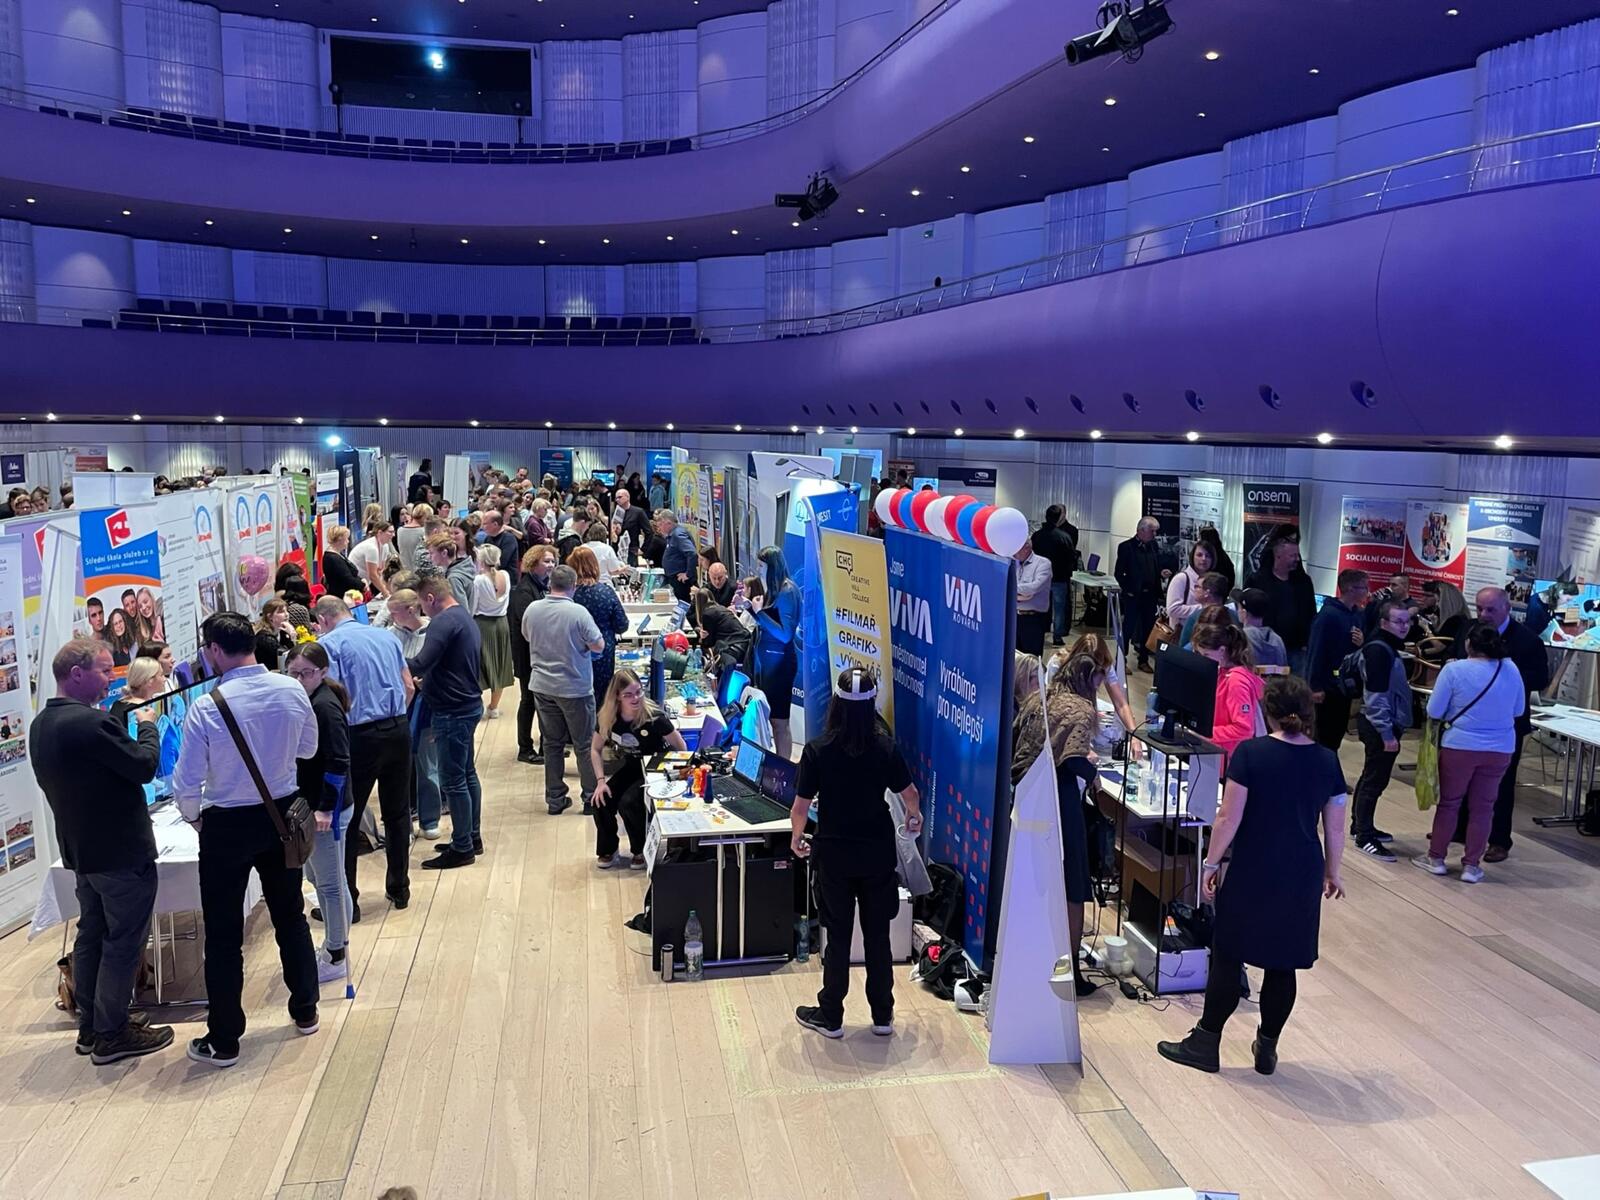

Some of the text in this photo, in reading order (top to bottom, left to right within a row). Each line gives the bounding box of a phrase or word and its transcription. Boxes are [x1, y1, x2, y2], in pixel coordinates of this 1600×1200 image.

[838, 555, 852, 567] CHC
[1345, 552, 1381, 564] SOCIÁLNÍ
[940, 659, 977, 704] Vyrábíme
[937, 694, 985, 744] pro nejlepší
